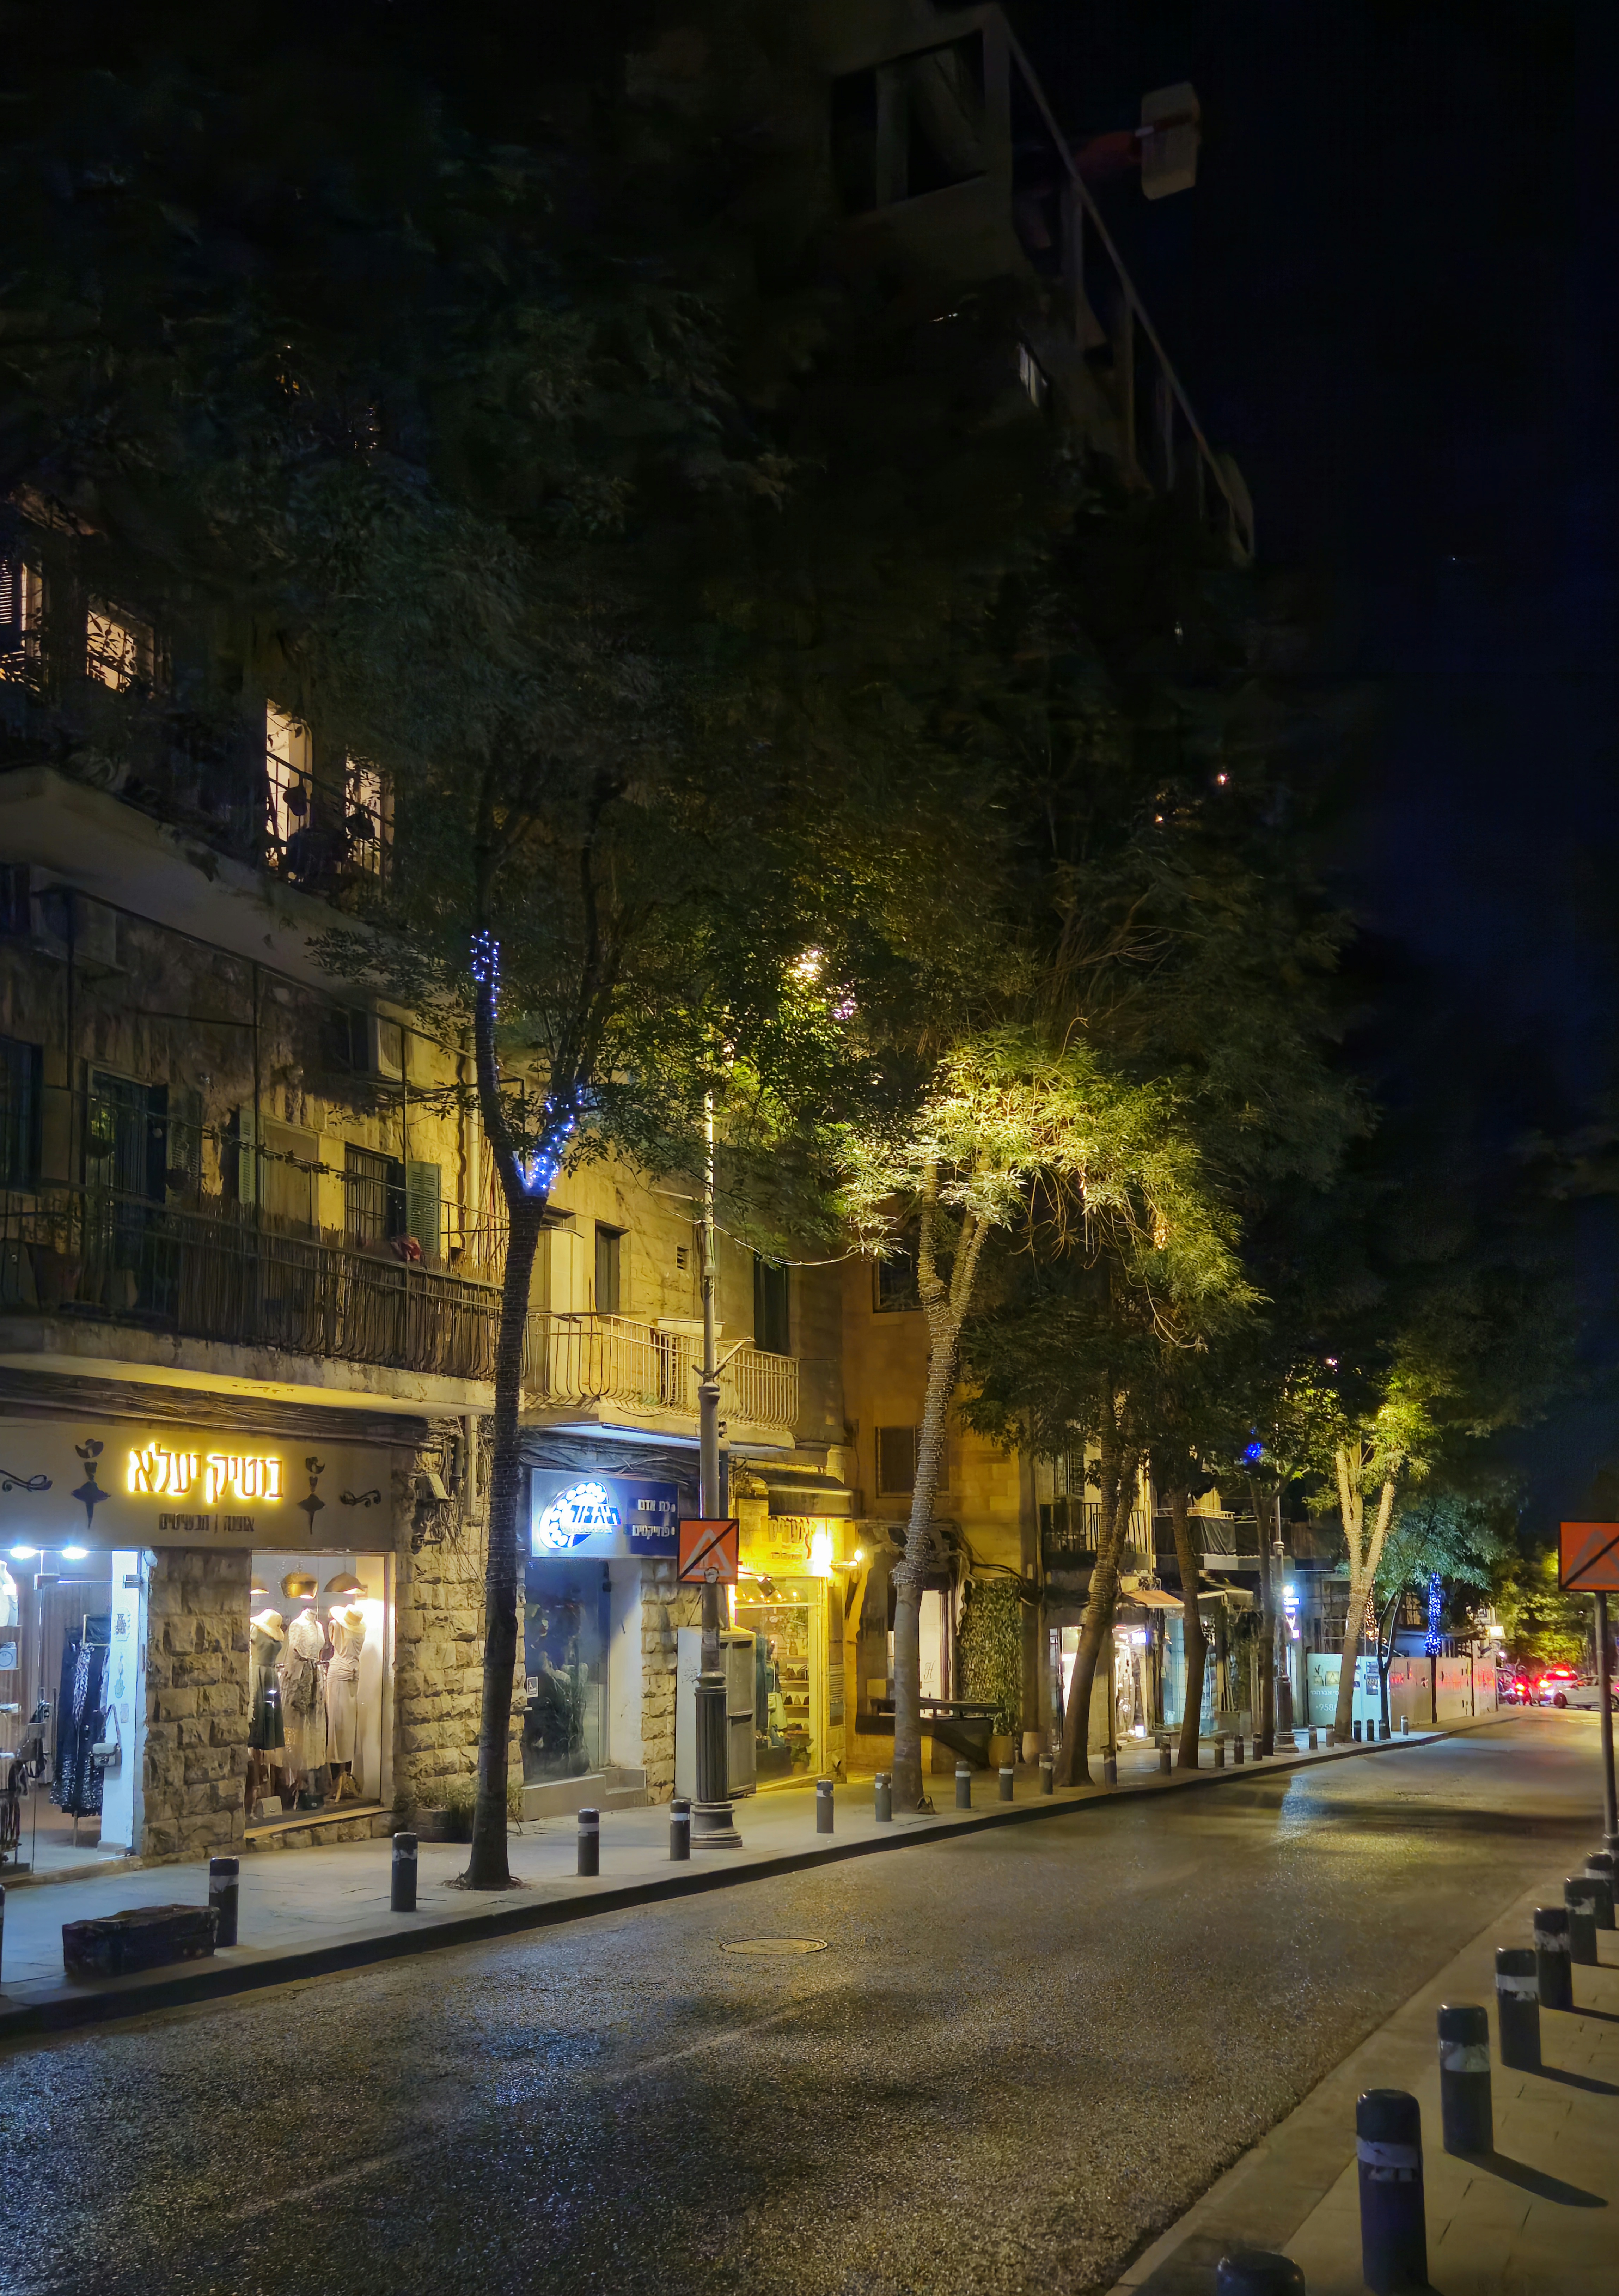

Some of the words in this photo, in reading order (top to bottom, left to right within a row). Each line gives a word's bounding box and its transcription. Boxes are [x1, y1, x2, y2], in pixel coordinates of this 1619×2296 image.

[134, 1443, 201, 1493] יעלא
[212, 1456, 283, 1503] בוטיק
[638, 1499, 656, 1511] אדם
